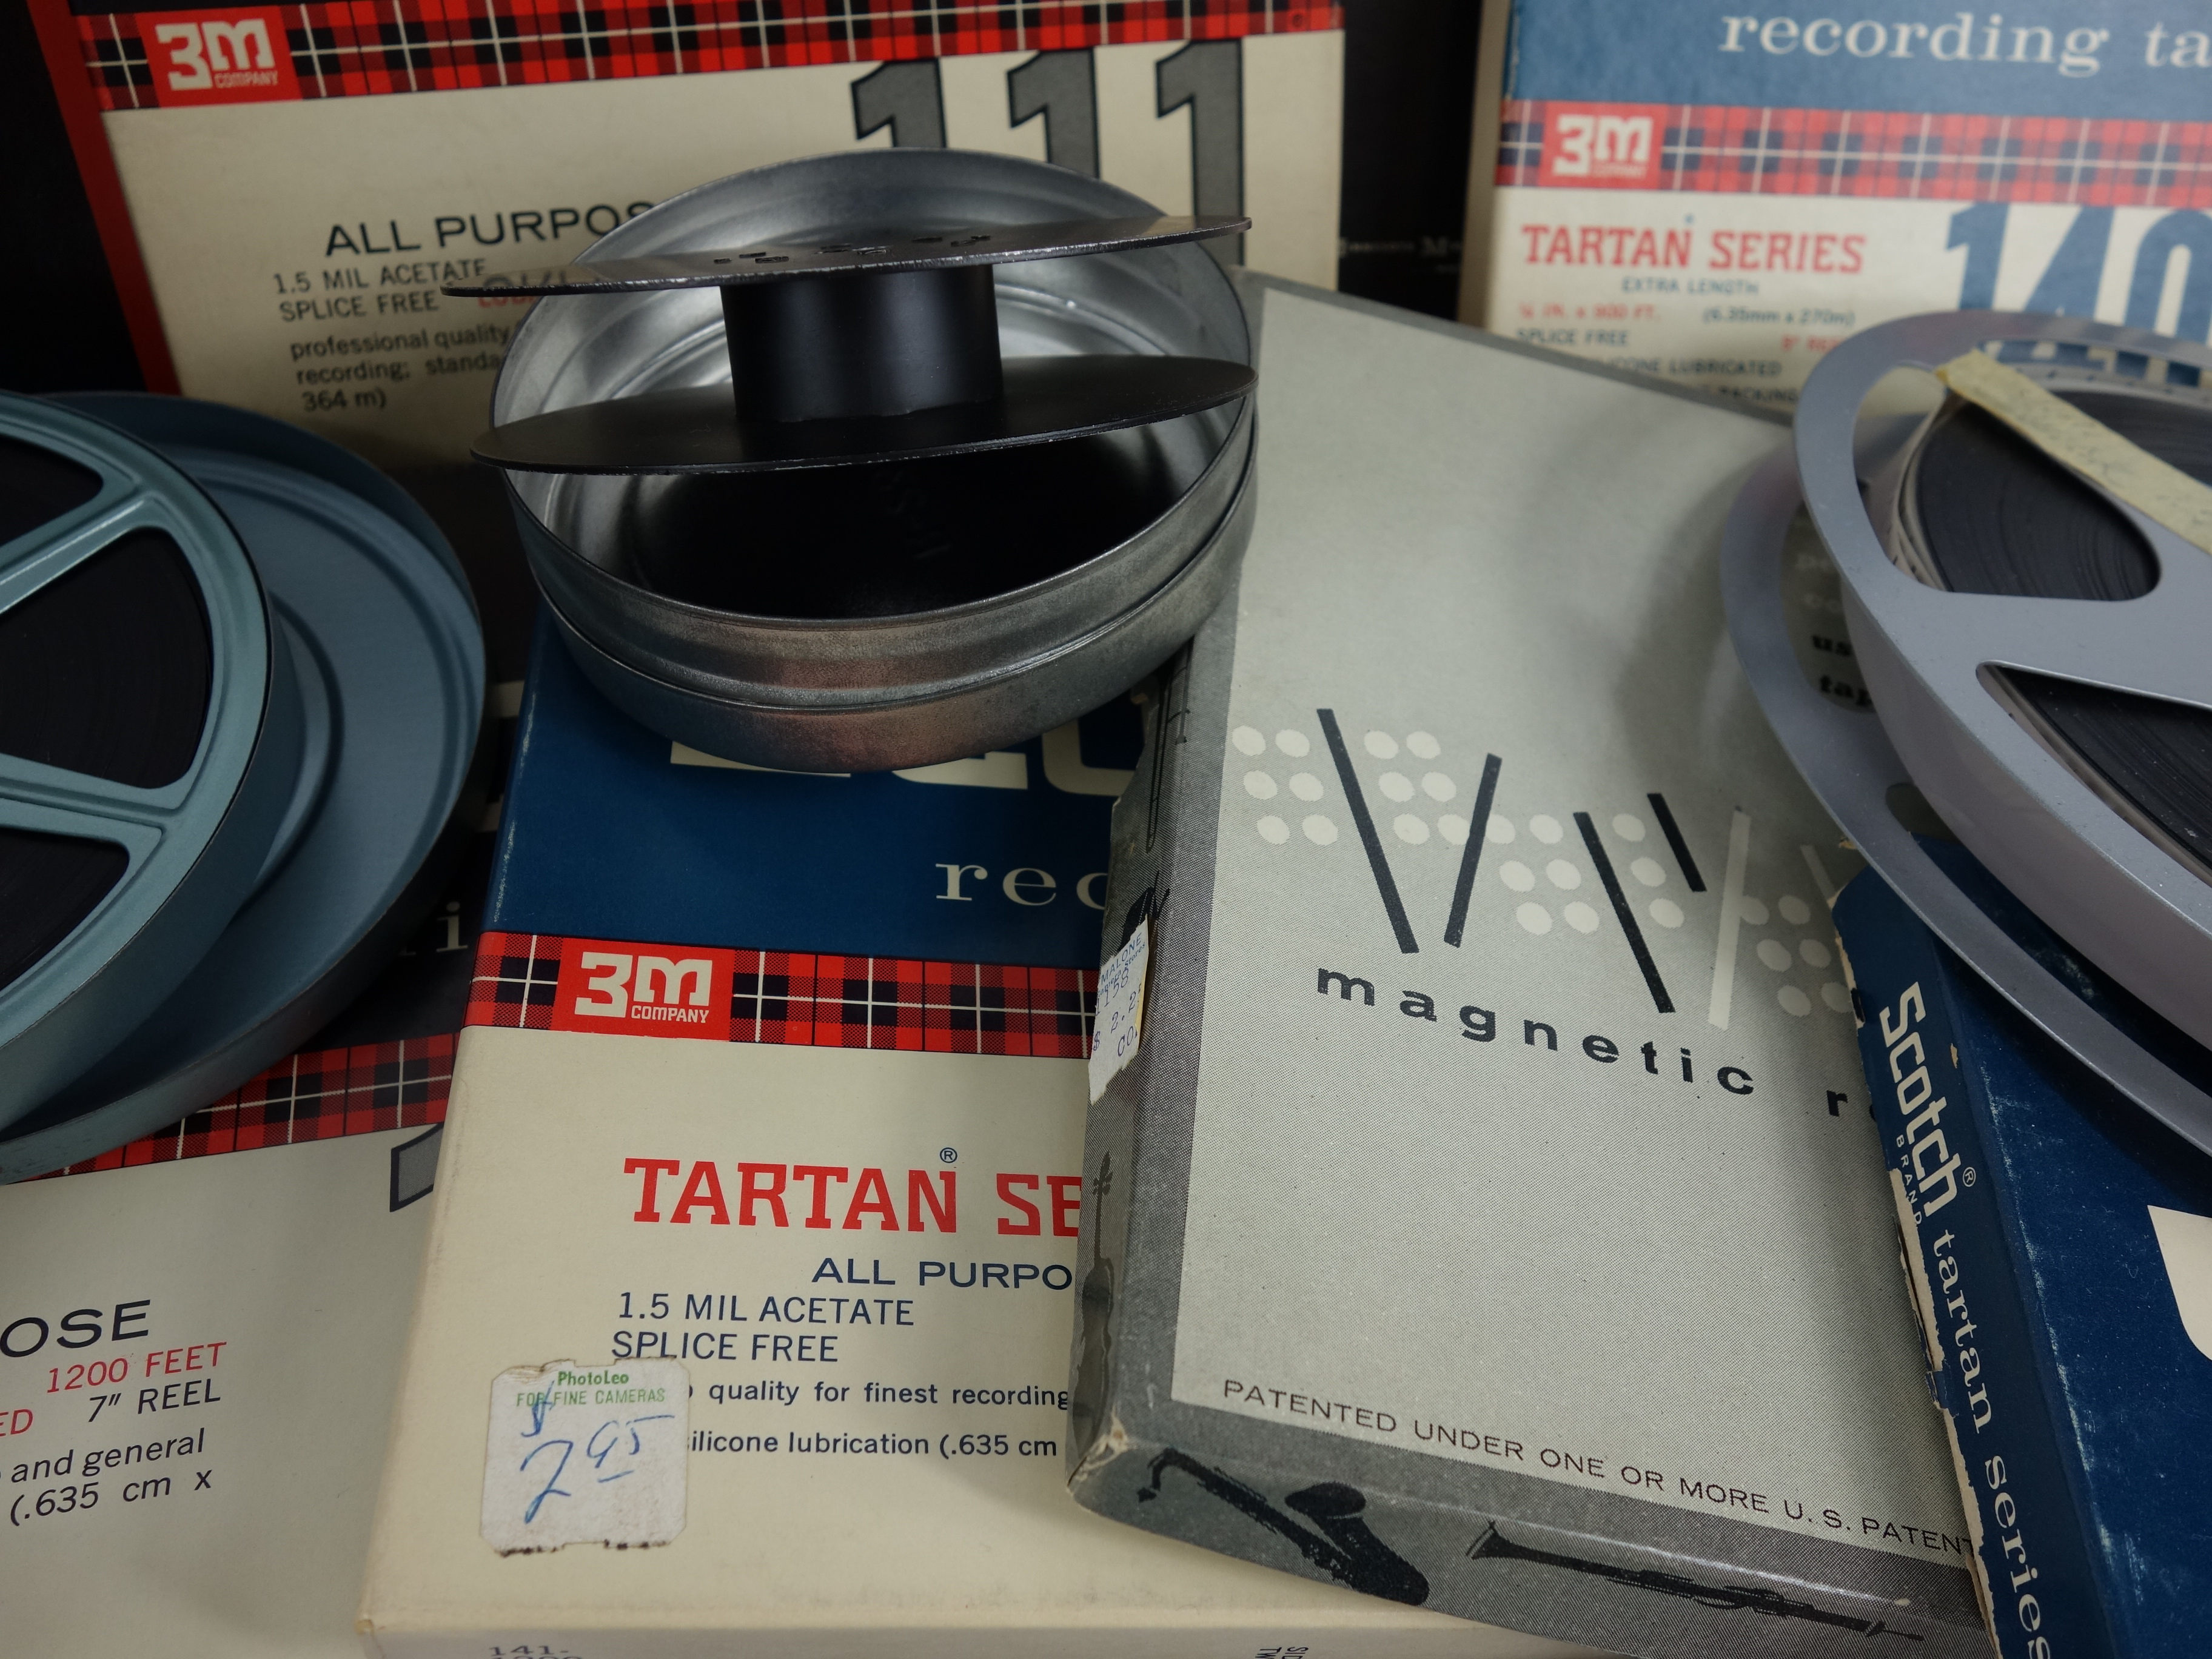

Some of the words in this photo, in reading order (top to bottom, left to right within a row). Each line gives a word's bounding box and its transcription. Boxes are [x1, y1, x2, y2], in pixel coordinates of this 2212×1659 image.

[155, 18, 275, 90] 3M
[1718, 12, 2110, 78] recording
[215, 71, 278, 88] COMPANY
[1553, 113, 1654, 176] 3M
[326, 220, 421, 257] ALL
[1708, 230, 1867, 275] SERIES
[274, 271, 312, 294] 1.5
[323, 267, 369, 291] MIL
[380, 258, 485, 286] ACETATE
[1621, 276, 1680, 293] EXTRA
[1687, 278, 1759, 295] LENGTH
[280, 295, 367, 323] SPLICE
[377, 290, 439, 315] FREE
[290, 328, 429, 361] professional
[434, 324, 510, 350] quality
[1517, 327, 1577, 346] SPLICE
[1584, 330, 1629, 347] FREE
[1668, 357, 1782, 378] LUBRICATED
[303, 389, 347, 412] 364
[354, 386, 386, 408] m)
[1101, 933, 1142, 985] MALONE
[575, 951, 712, 1018] 3M
[631, 1004, 709, 1024] COMPANY
[1317, 967, 1755, 1096] magnetic
[1895, 1134, 1923, 1225] BRAND
[811, 1257, 897, 1285] ALL
[918, 1261, 1073, 1291] PURPO
[618, 1292, 670, 1319] 1.5
[685, 1294, 748, 1322] MIL
[759, 1296, 914, 1327] ACETATE
[611, 1330, 738, 1362] SPLICE
[751, 1335, 839, 1363] FREE
[1933, 1228, 1992, 1434] tartan
[46, 1357, 129, 1393] 1200
[144, 1341, 227, 1378] FEET
[557, 1370, 630, 1386] PhotoLeo
[137, 1378, 222, 1415] REEL
[516, 1392, 546, 1407] FOR
[553, 1391, 588, 1406] FINE
[595, 1388, 666, 1405] CAMERAS
[708, 1380, 800, 1406] quality
[814, 1381, 850, 1403] for
[863, 1382, 938, 1404] finest
[952, 1386, 1068, 1410] recording
[11, 1449, 74, 1483] and
[81, 1427, 205, 1476] general
[687, 1430, 779, 1453] ilicone
[788, 1432, 929, 1455] lubrication
[939, 1434, 1009, 1460] (.635
[1018, 1440, 1057, 1456] cm
[1224, 1378, 1396, 1433] PATENTED
[1414, 1419, 1524, 1461] UNDER
[1540, 1449, 1605, 1478] ONE
[1621, 1466, 1664, 1492] OR
[1679, 1476, 1770, 1514] MORE
[10, 1482, 99, 1527] (.635
[122, 1476, 172, 1501] cm
[193, 1469, 213, 1491] x
